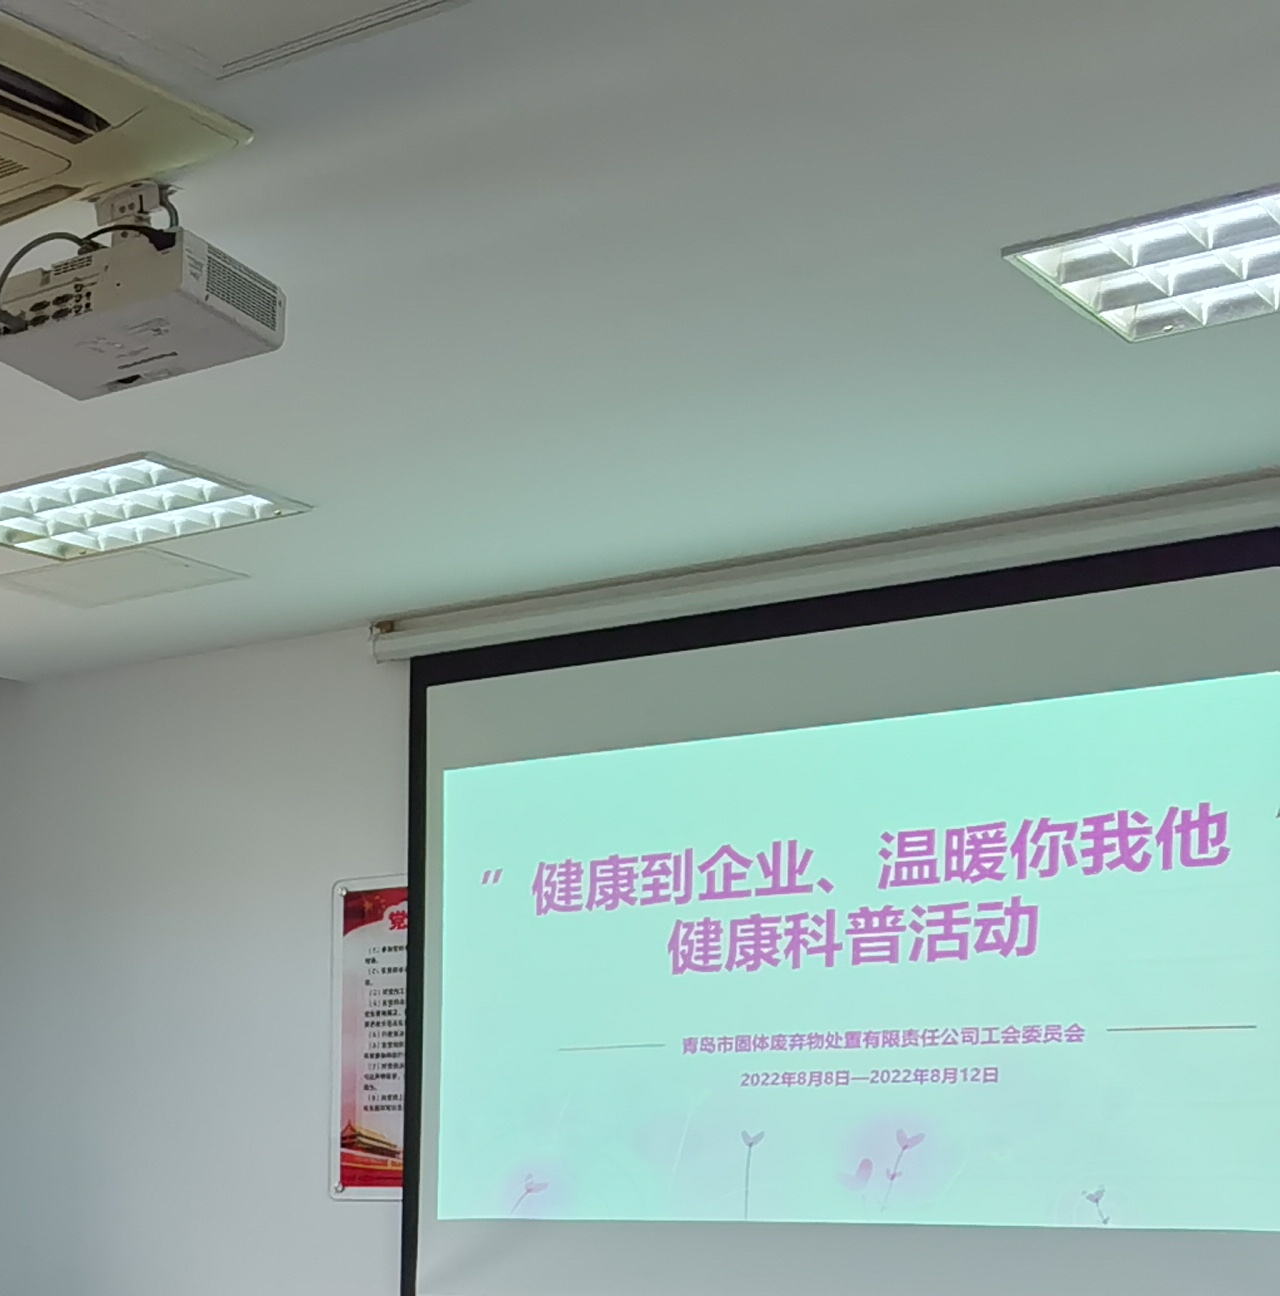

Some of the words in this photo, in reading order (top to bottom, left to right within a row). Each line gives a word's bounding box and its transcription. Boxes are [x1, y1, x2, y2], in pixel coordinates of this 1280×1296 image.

[667, 895, 1039, 975] 健康科普活动
[682, 1023, 1086, 1054] 青岛市固体废弃物处置有限责任公司工会委员会
